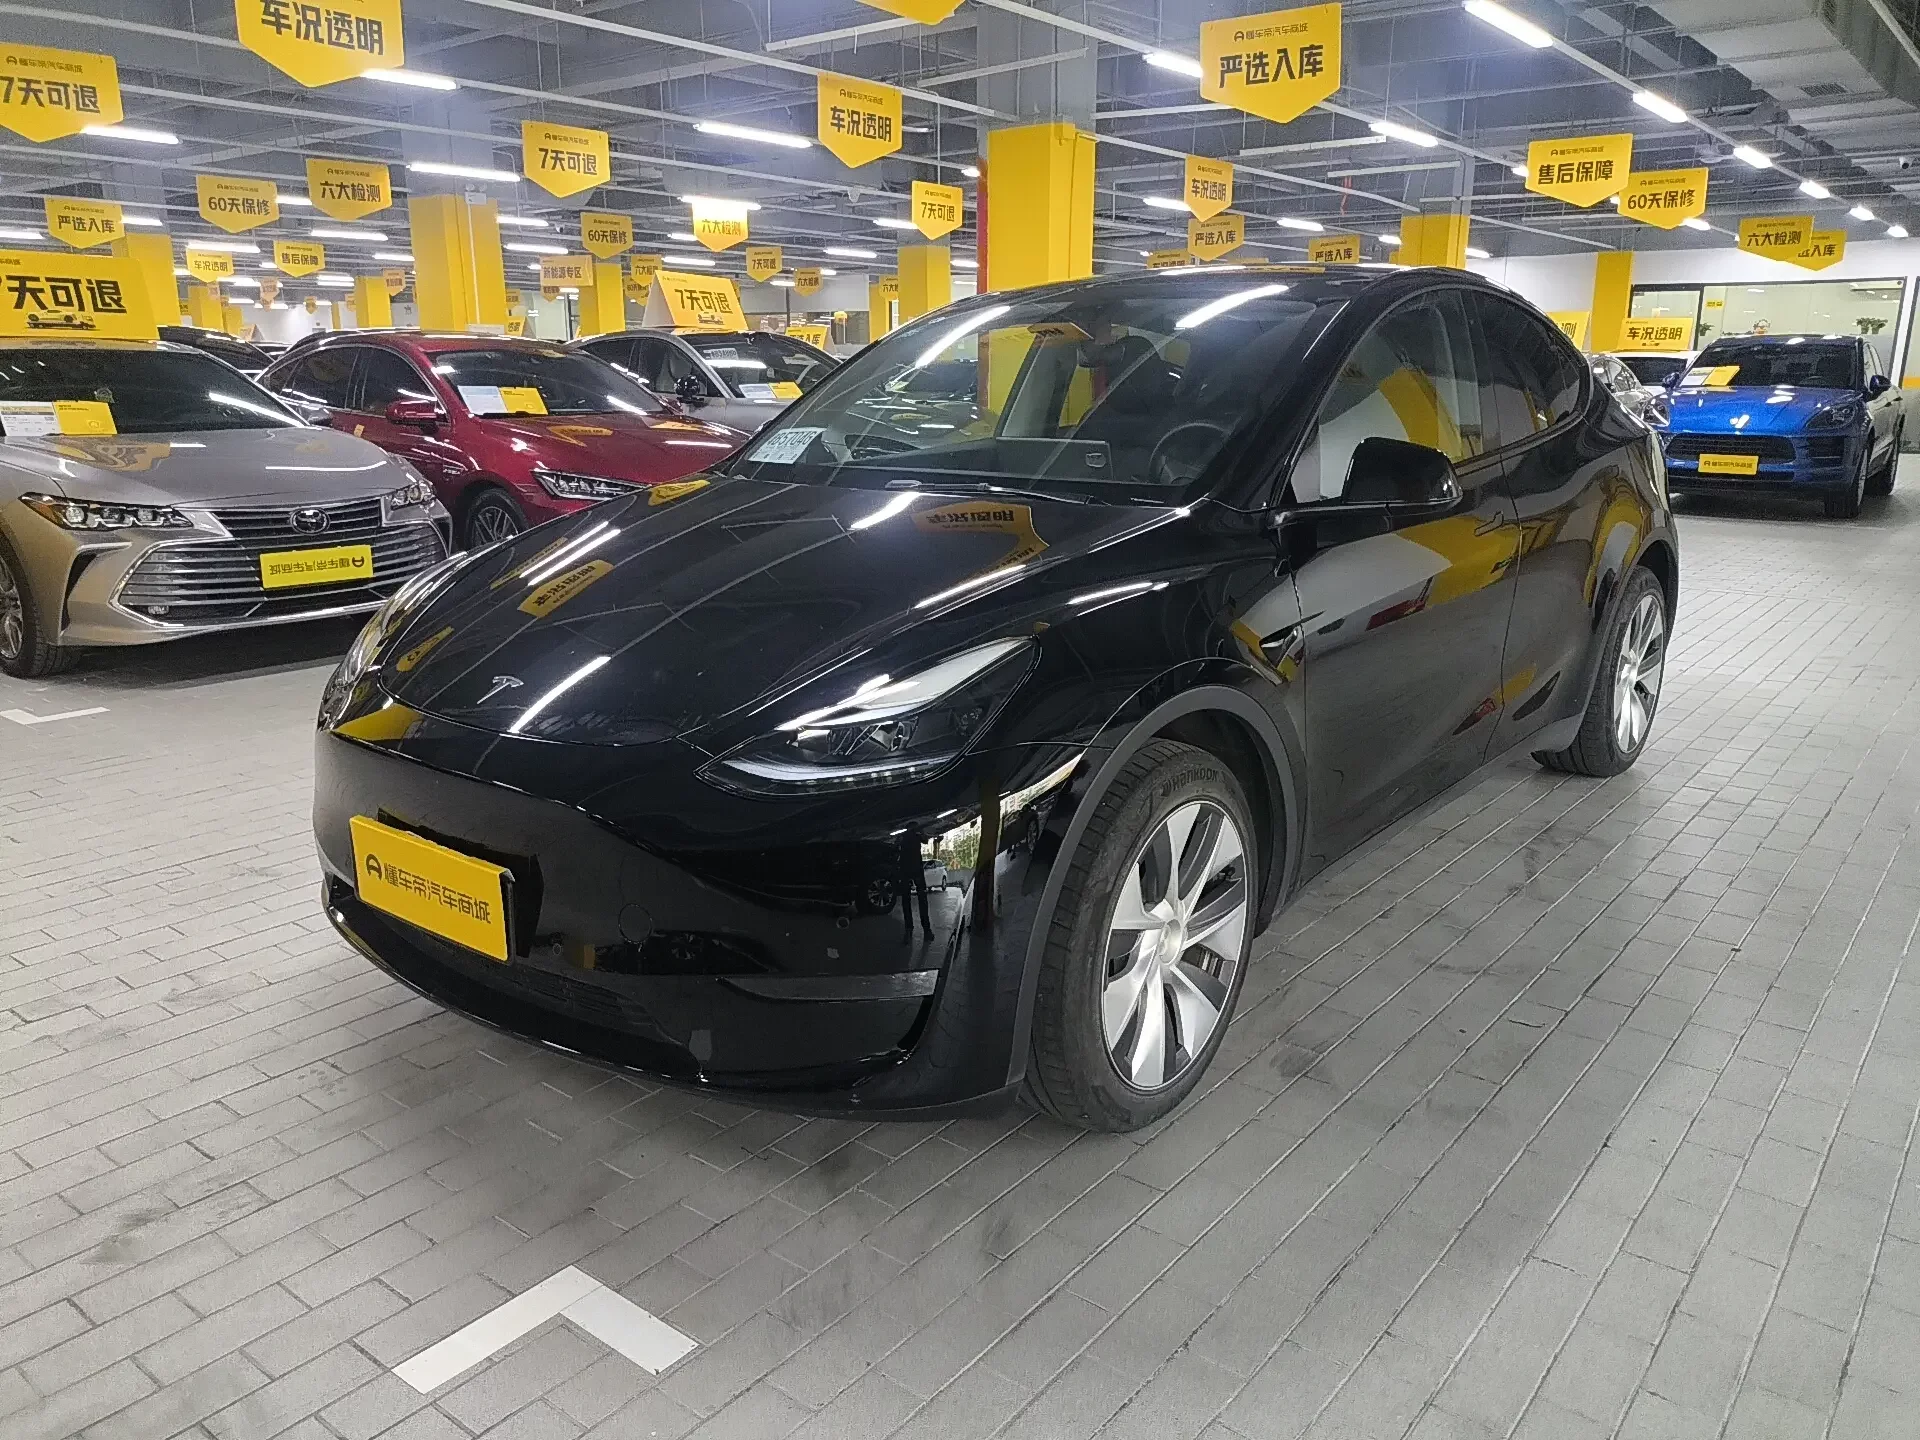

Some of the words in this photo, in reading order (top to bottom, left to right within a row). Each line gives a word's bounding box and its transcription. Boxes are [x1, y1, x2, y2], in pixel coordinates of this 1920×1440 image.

[260, 0, 384, 55] 车况透明
[1219, 44, 1324, 88] 严选入库
[0, 76, 100, 114] 7天可退
[830, 106, 892, 142] 车况透明
[538, 147, 597, 175] 7天可退
[1538, 160, 1614, 185] 售后保障
[320, 180, 382, 203] 六大检测
[1191, 178, 1227, 202] 车况透明
[1627, 189, 1697, 211] 60天保修
[208, 196, 271, 217] 60天保修
[921, 201, 956, 222] 7天可退
[57, 215, 116, 234] 严选入库
[701, 219, 742, 236] 六大检测
[588, 229, 628, 245] 60天保修
[1194, 230, 1237, 247] 严选入库
[1747, 230, 1803, 247] 六大检测
[281, 252, 319, 266] 售后保障
[751, 258, 777, 270] 7天可退
[1315, 248, 1353, 262] 严选入库
[193, 260, 228, 273] 车况透明
[543, 266, 583, 280] 新能源专区
[0, 274, 127, 314] 天可退
[675, 289, 733, 314] 7天可退
[1627, 326, 1683, 341] 车况透明
[384, 862, 492, 925] 懂车帝汽车商城
